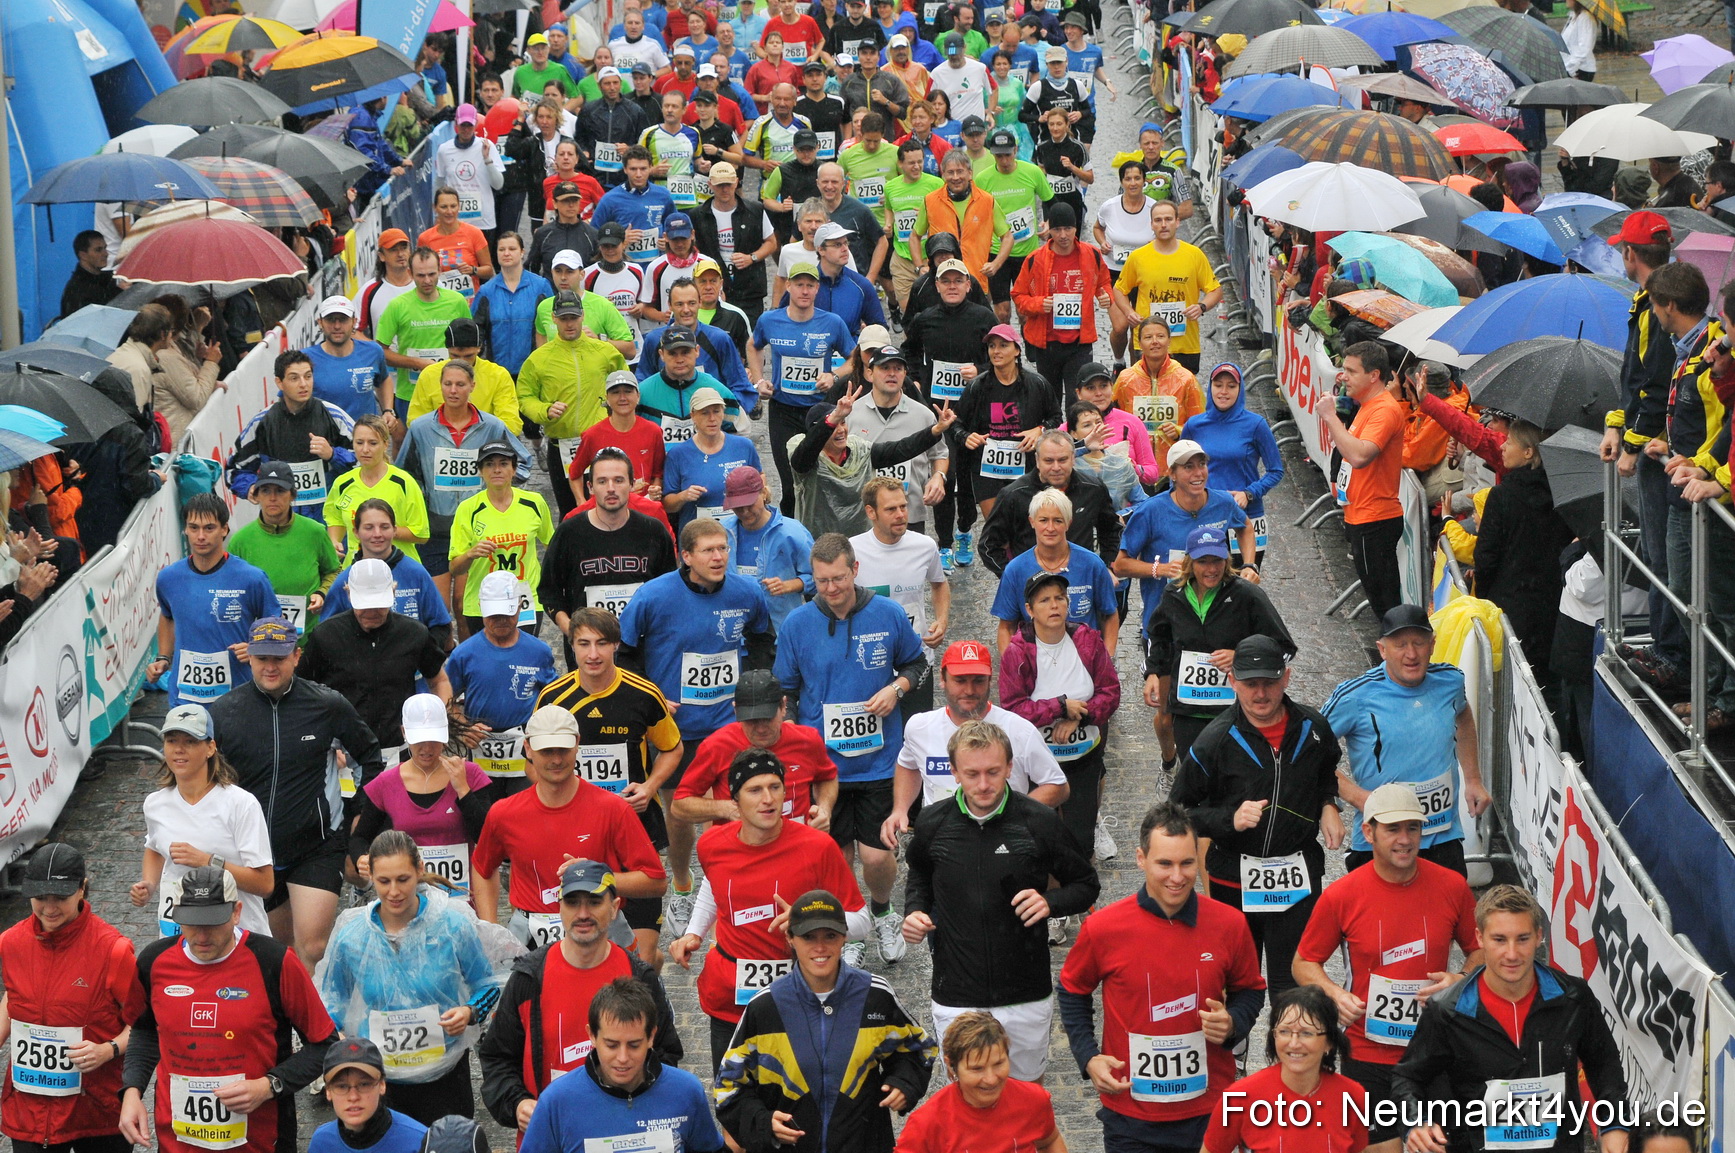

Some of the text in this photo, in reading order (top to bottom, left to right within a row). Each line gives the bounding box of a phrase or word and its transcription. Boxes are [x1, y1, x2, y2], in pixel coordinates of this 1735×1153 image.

[785, 47, 806, 58] 2687
[597, 149, 623, 163] 2015
[670, 181, 694, 194] 2806
[857, 183, 885, 199] 2759
[784, 366, 819, 381] 2754
[789, 382, 812, 391] Andreas
[1137, 405, 1175, 422] 3269
[986, 448, 1023, 466] 3019
[438, 458, 479, 478] 2883
[992, 467, 1014, 475] Kerstin
[449, 478, 467, 487] Julia
[485, 532, 528, 545] Müller
[496, 552, 518, 572] M
[579, 556, 648, 576] AND1
[859, 631, 889, 641] NEUMARKTER
[183, 664, 227, 685] 2836
[687, 664, 735, 687] 2873
[191, 686, 216, 697] Robert
[694, 687, 725, 700] Joachim
[1191, 688, 1221, 699] Barbara
[600, 726, 629, 735] ABI 09
[830, 713, 878, 738] 2868
[836, 738, 874, 751] Johannes
[490, 762, 511, 772] Horst
[0, 797, 31, 842] SEAT
[1248, 864, 1304, 890] 2846
[194, 887, 210, 897] TAO
[1263, 892, 1291, 905] Albert
[801, 904, 835, 912] WORRIES
[745, 909, 764, 921] DEHN
[1394, 946, 1413, 959] DEHN
[1165, 1002, 1184, 1014] DEHN
[193, 1009, 213, 1021] GfK
[867, 1011, 887, 1020] adidas
[28, 1027, 58, 1038] BOCK
[382, 1025, 430, 1053] 522
[1151, 1038, 1184, 1048] BOCK
[16, 1039, 75, 1071] 2585
[1136, 1049, 1200, 1078] 2013
[19, 1070, 68, 1088] Eva-Maria
[1151, 1081, 1188, 1096] Philipp
[183, 1095, 232, 1124] 460
[636, 1115, 688, 1128] 12. NEUMARKTER
[1503, 1126, 1551, 1140] Matthias
